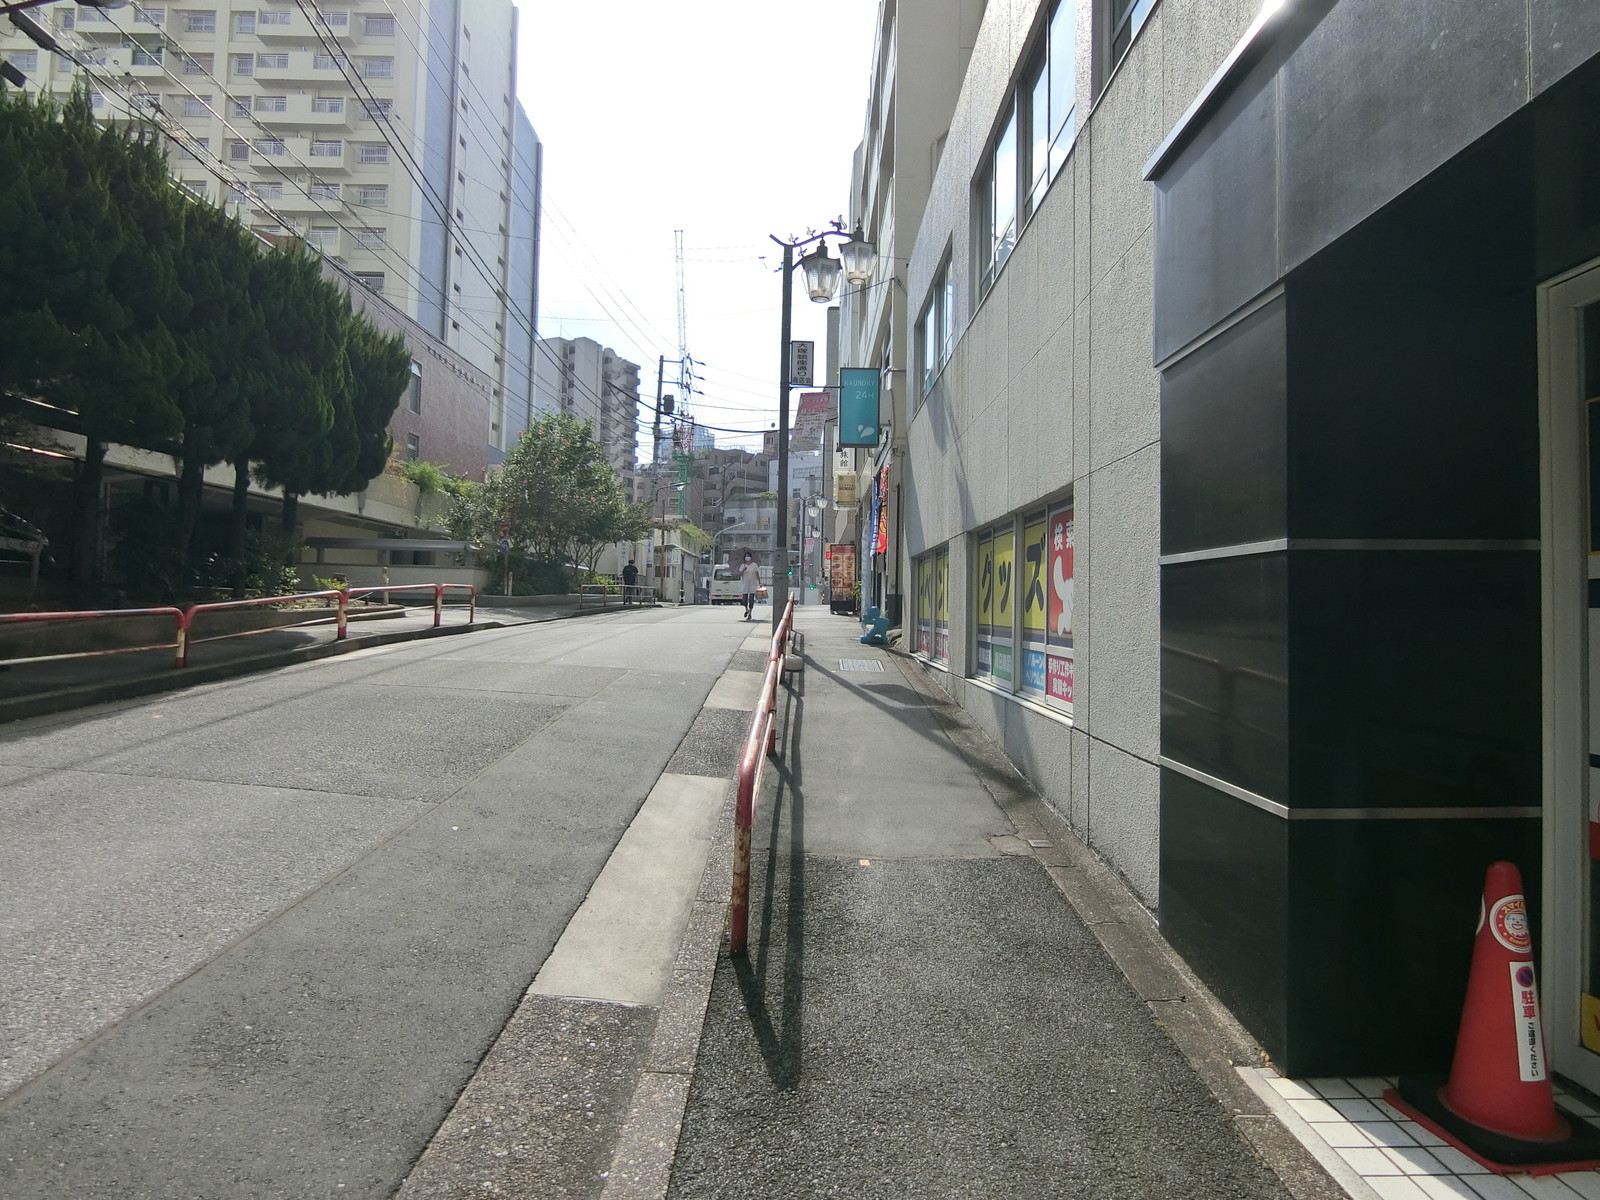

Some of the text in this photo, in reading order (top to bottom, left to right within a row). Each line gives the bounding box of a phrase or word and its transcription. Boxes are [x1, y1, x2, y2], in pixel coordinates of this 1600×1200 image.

[855, 390, 874, 400] 24H
[1053, 519, 1074, 552] 検索
[981, 532, 1046, 615] グッズ
[1521, 990, 1539, 1077] 駐車 ご遠慮ください
